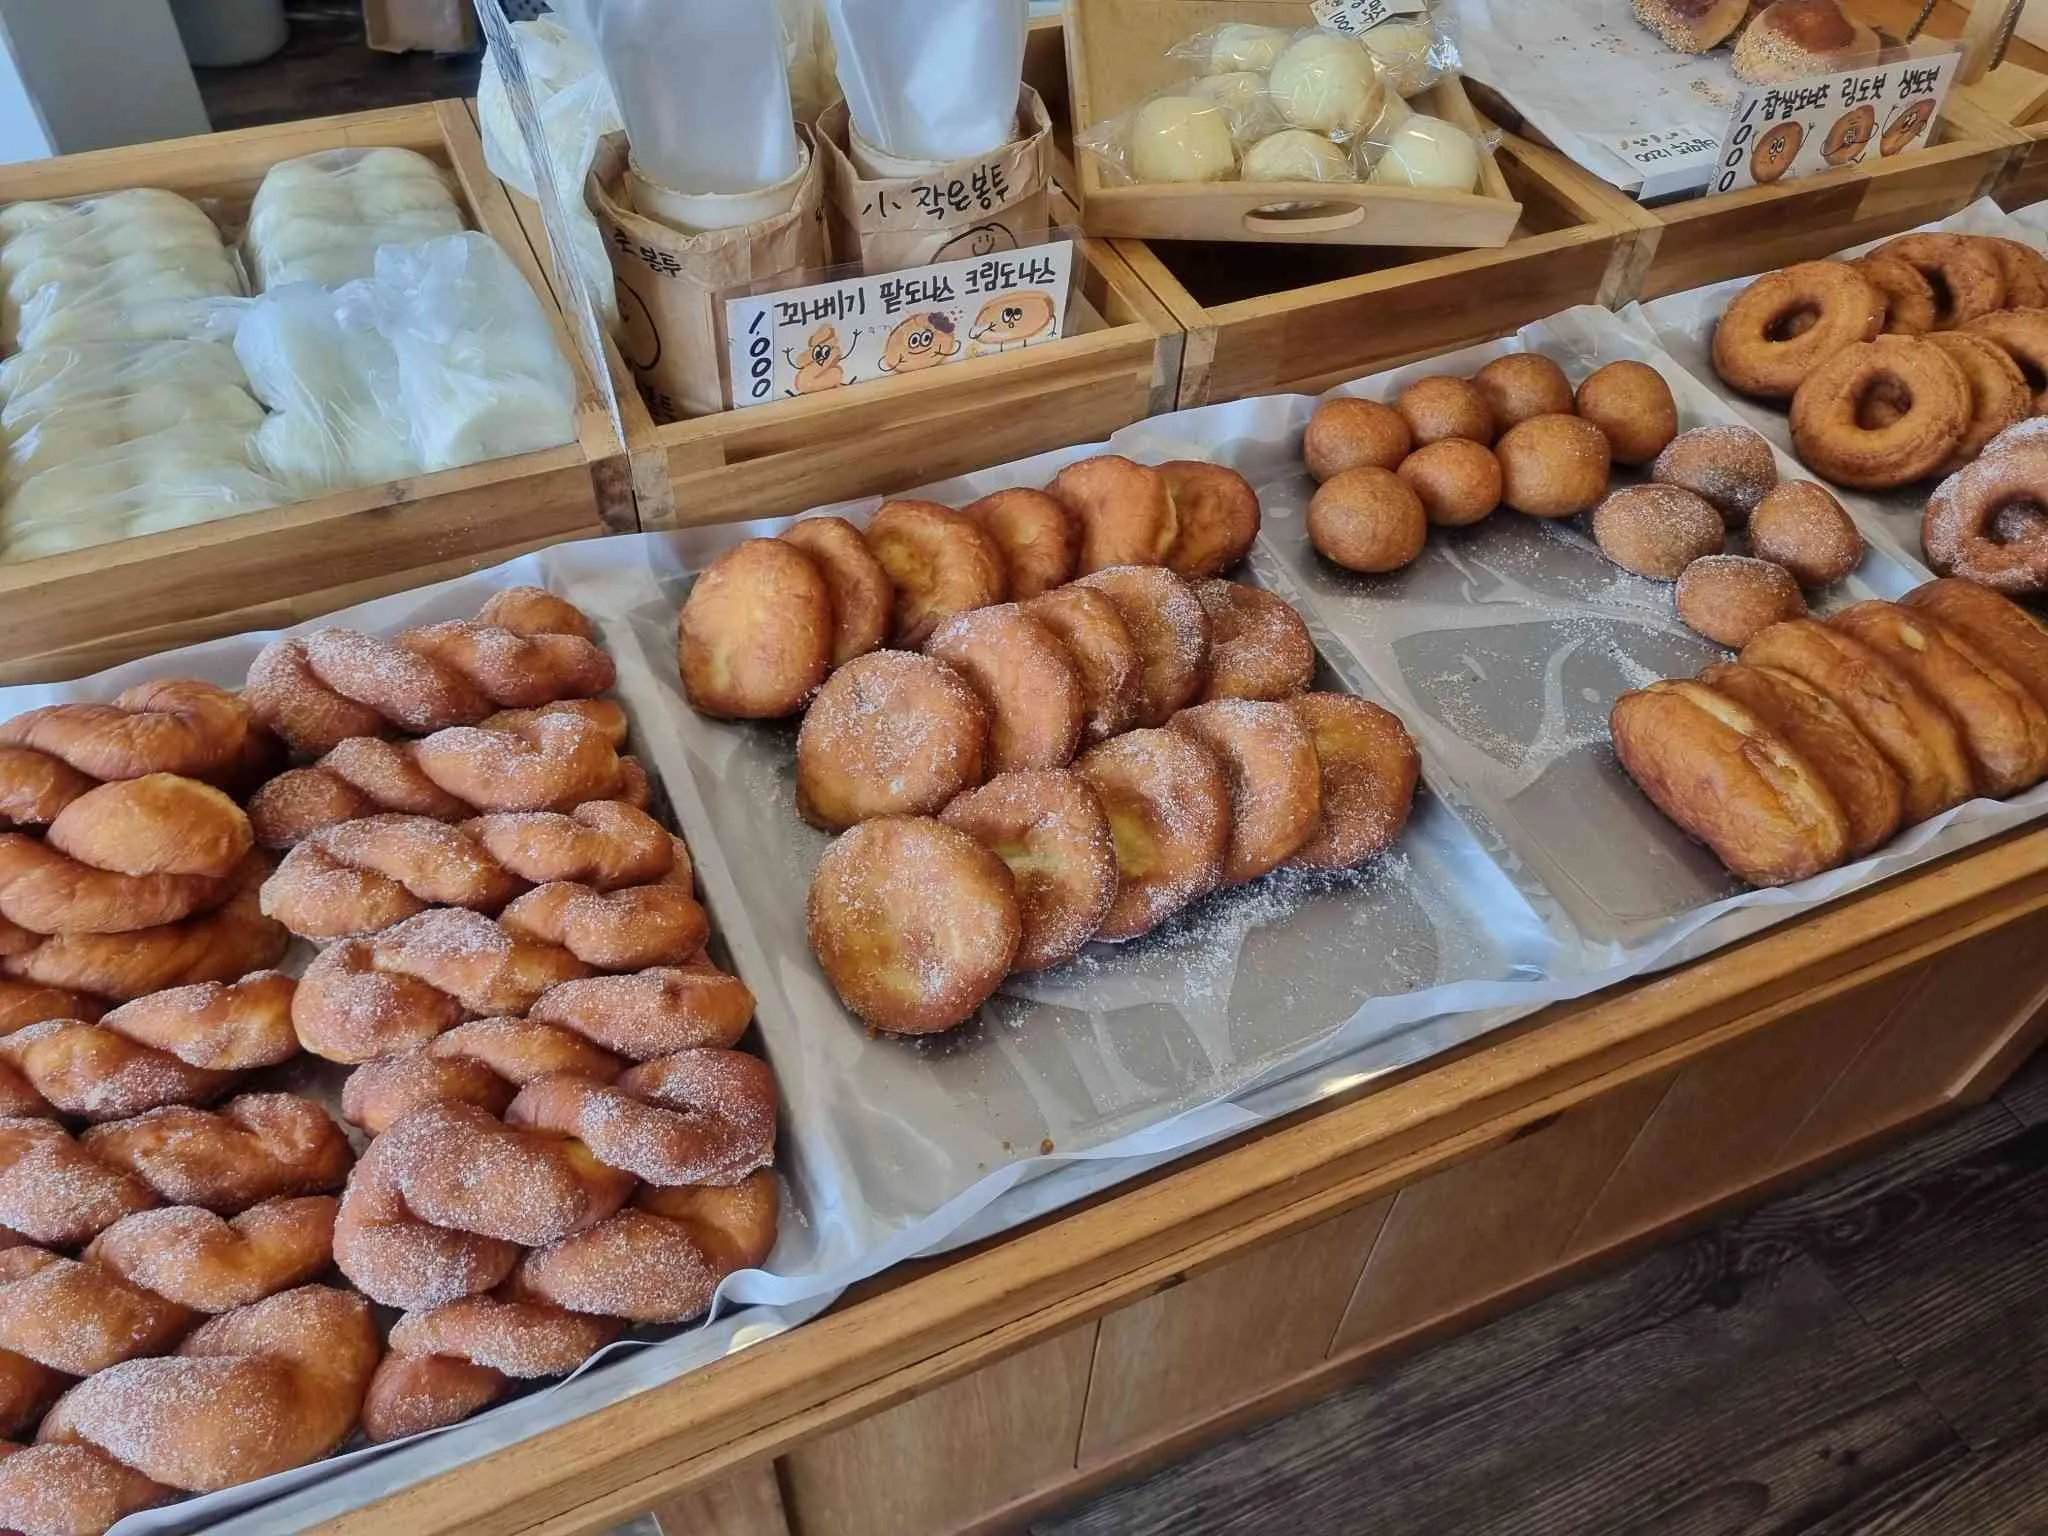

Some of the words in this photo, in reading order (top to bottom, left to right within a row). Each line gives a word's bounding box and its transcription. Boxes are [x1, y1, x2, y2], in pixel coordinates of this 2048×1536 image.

[1718, 99, 1758, 192] 1000
[880, 276, 956, 314] 팥도나스
[964, 257, 1056, 294] 크림도나스
